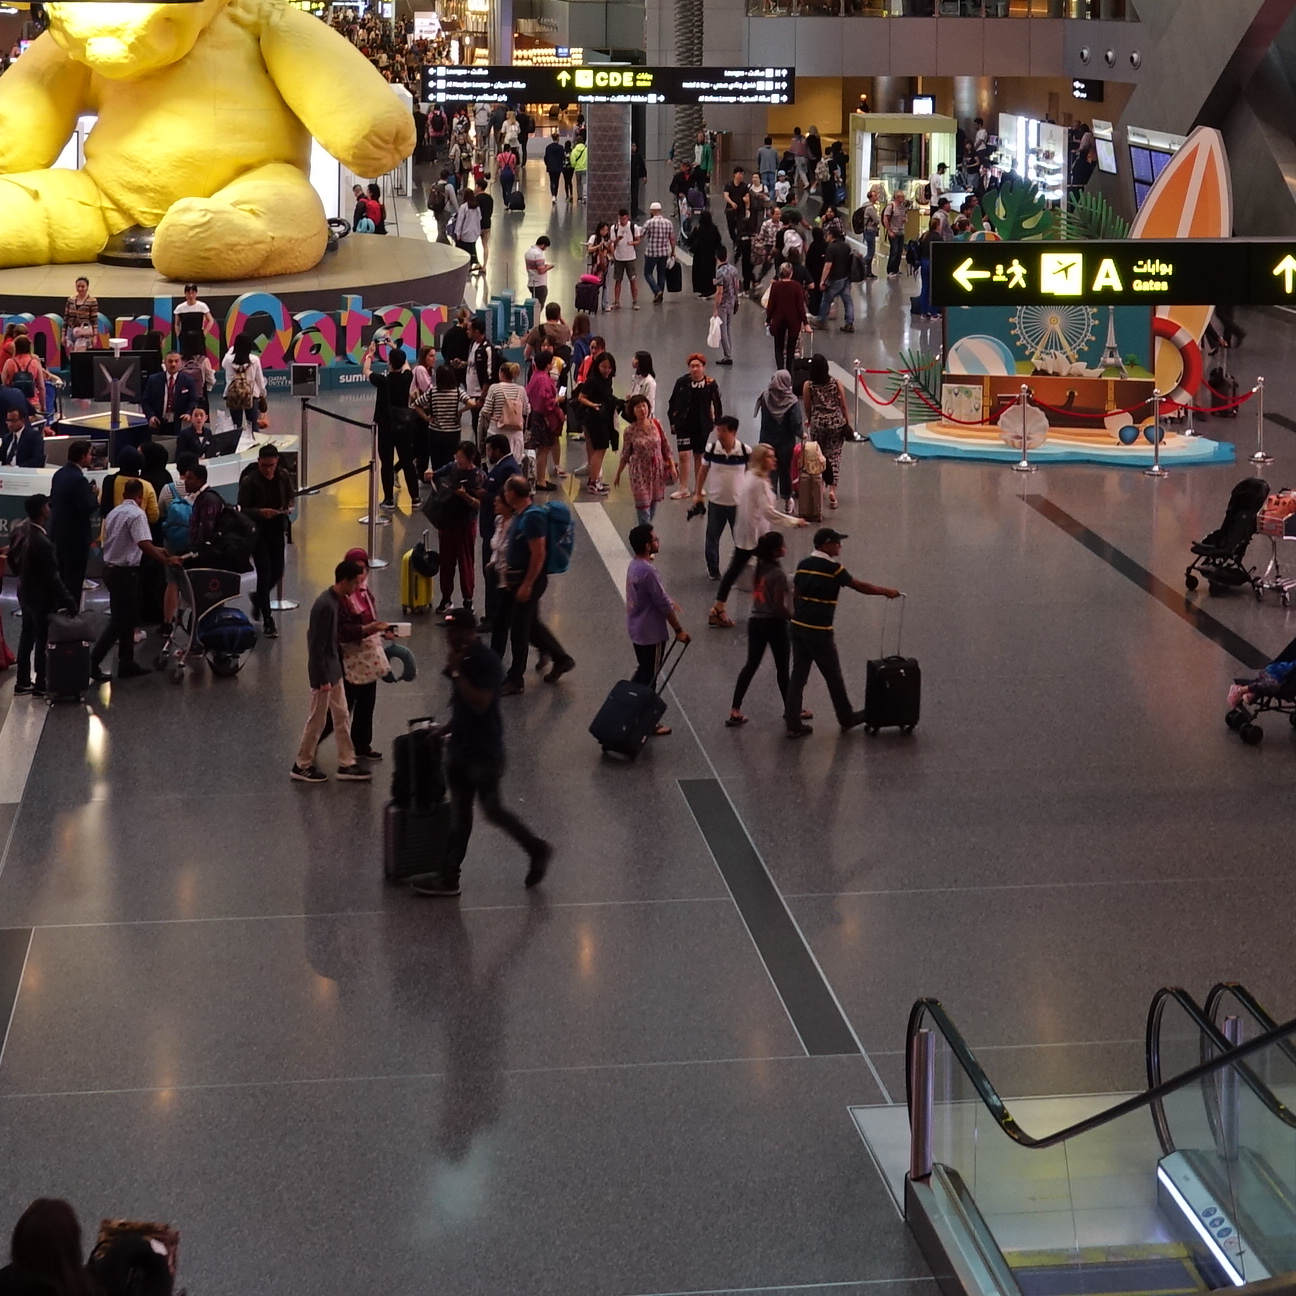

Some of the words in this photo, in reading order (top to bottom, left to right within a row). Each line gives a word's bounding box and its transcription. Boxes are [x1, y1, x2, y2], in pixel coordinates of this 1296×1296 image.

[595, 71, 633, 86] CDE
[1092, 258, 1123, 291] A
[1133, 259, 1172, 275] بوابات
[1132, 279, 1168, 291] Gates
